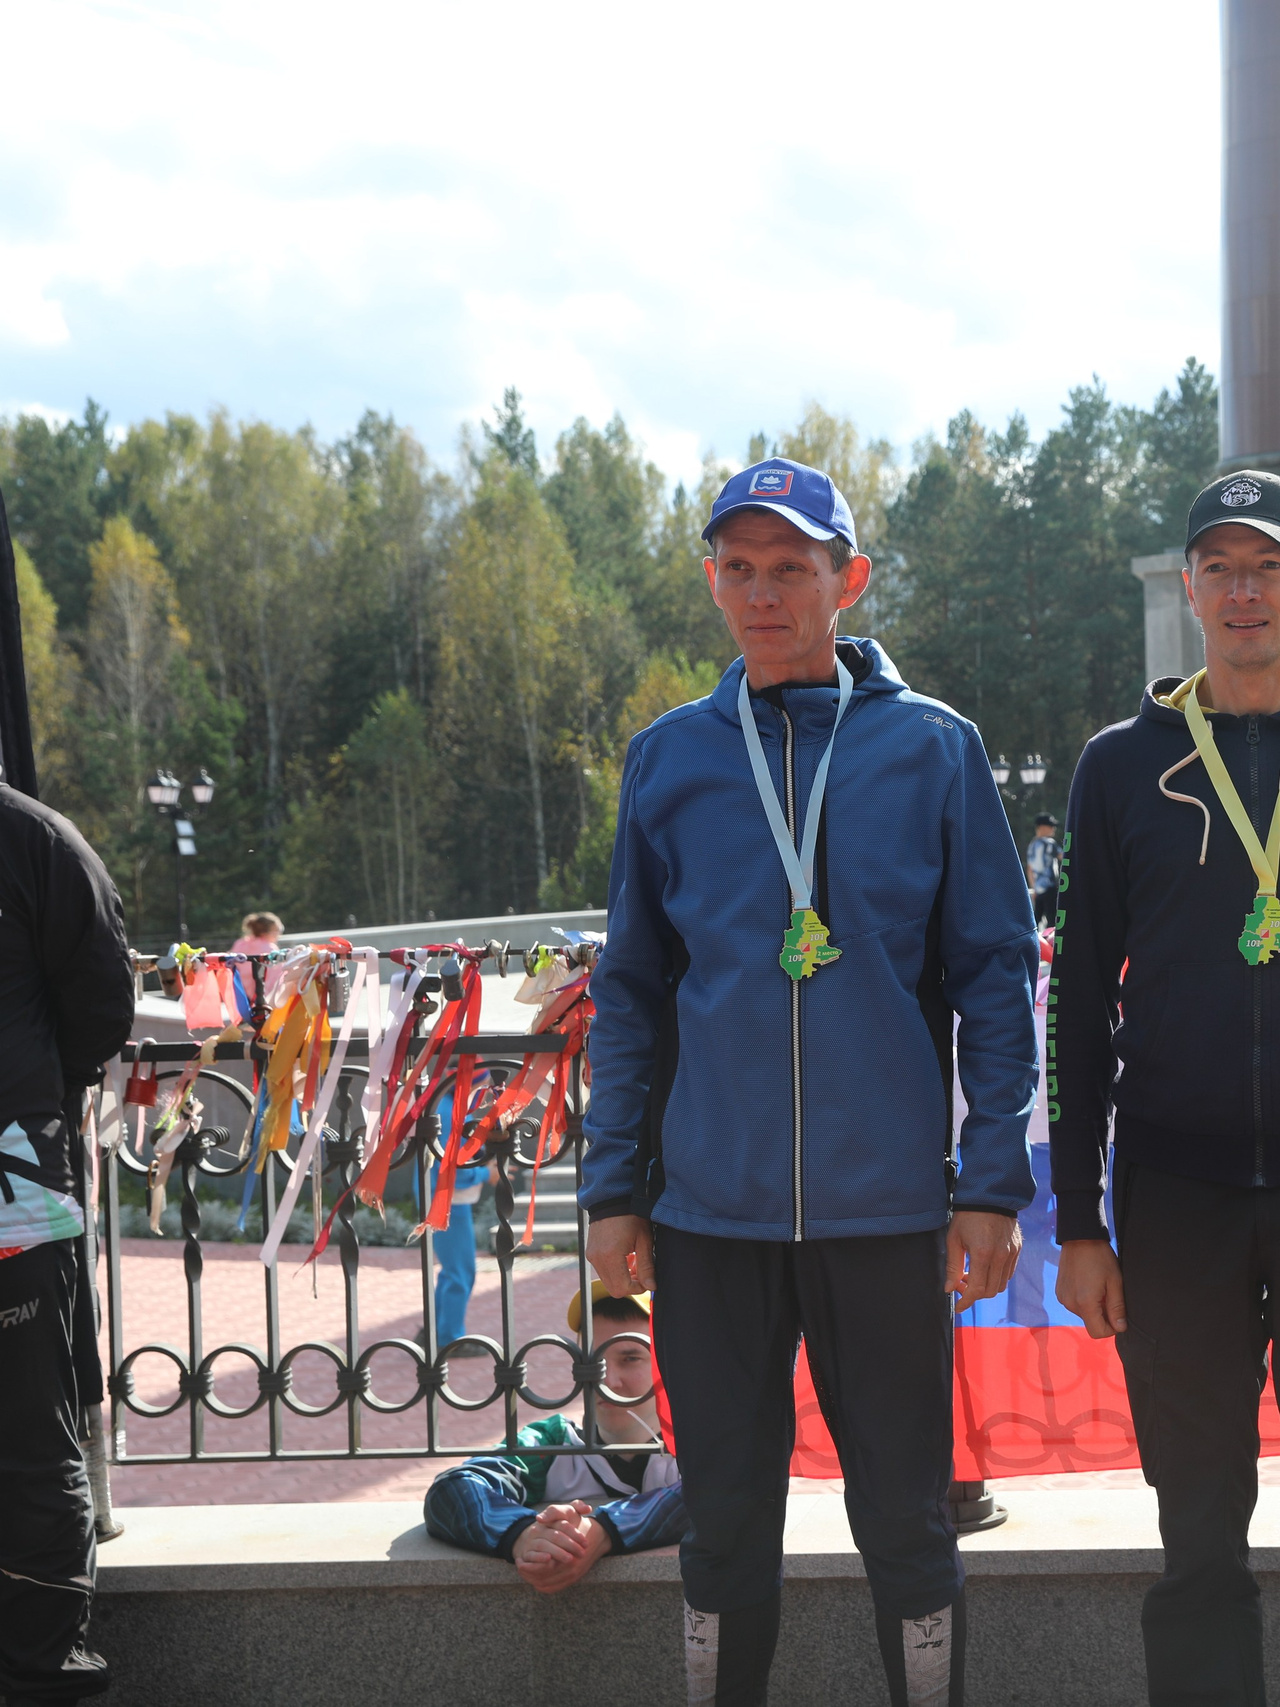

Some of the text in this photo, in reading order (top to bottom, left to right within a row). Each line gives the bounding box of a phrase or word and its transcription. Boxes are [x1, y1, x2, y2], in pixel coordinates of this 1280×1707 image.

[923, 713, 954, 729] CMP
[810, 933, 824, 941] 101
[1246, 939, 1261, 947] 101
[788, 954, 803, 962] 101
